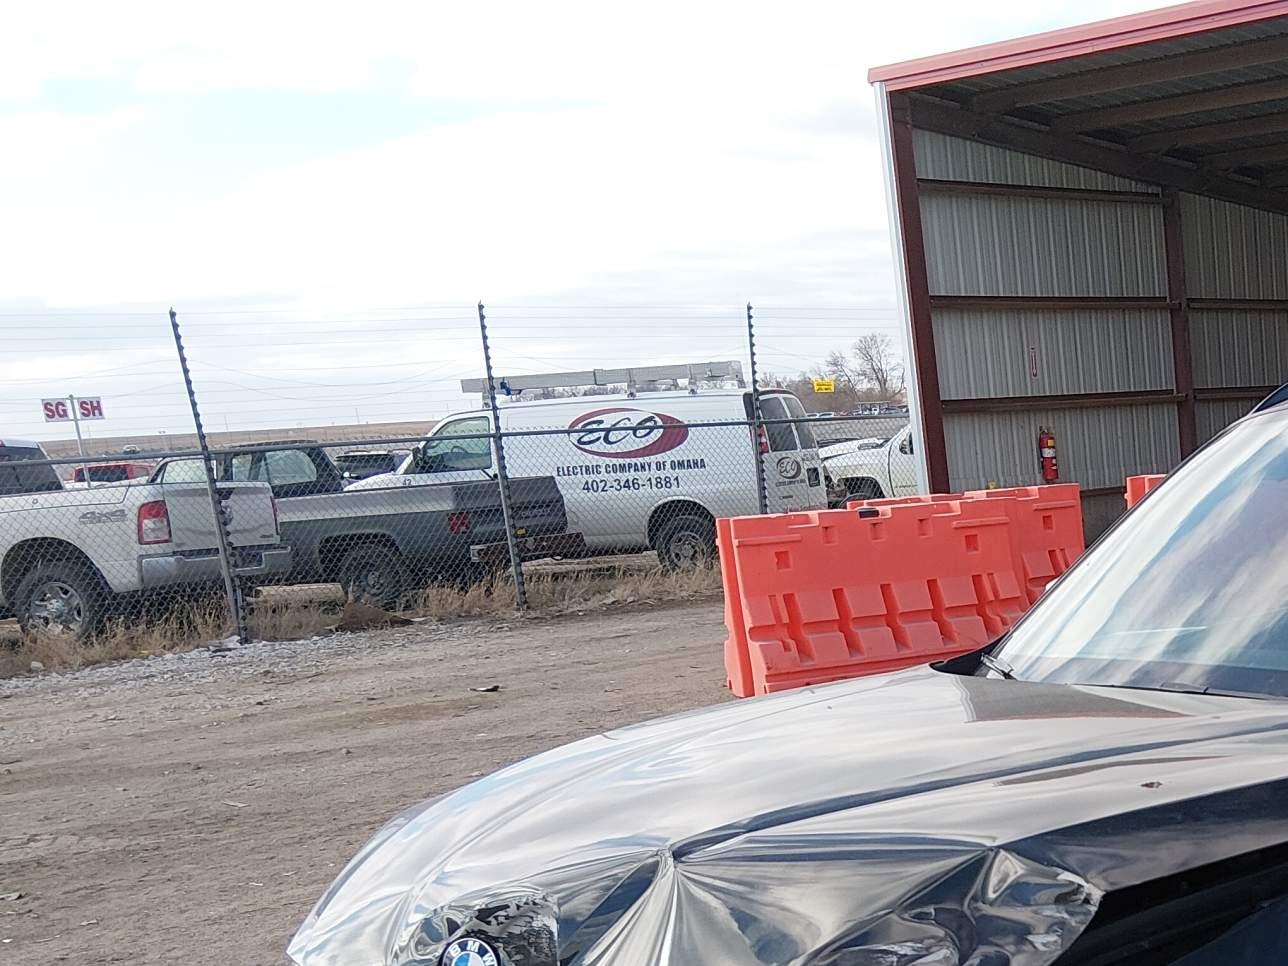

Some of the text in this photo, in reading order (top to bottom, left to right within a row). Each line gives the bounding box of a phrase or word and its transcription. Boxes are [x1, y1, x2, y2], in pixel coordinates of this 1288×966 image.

[43, 401, 68, 419] SG
[79, 400, 103, 418] SH
[576, 415, 658, 446] ECO
[556, 458, 707, 477] ELECTRIC COMPANY OF OMAHA
[582, 476, 681, 493] 402-346-1881
[449, 940, 495, 966] BMW
